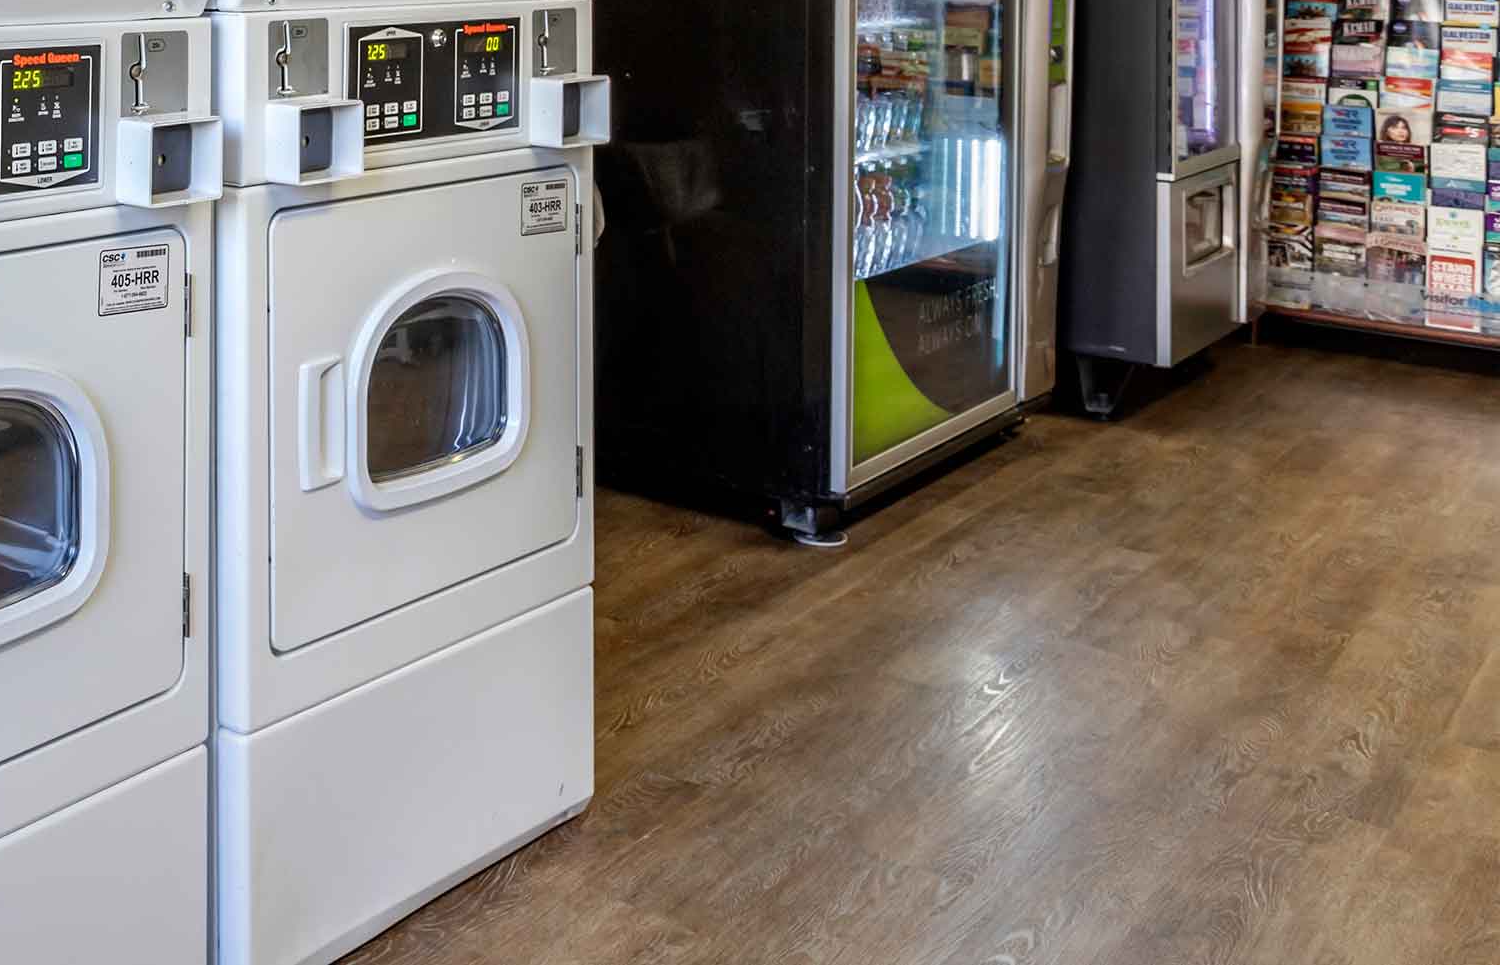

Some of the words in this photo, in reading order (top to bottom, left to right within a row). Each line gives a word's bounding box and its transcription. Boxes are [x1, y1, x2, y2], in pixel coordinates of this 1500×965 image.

[486, 37, 499, 51] 00
[13, 54, 46, 67] Speed
[48, 53, 80, 63] Queen
[13, 70, 41, 89] 2.25
[103, 254, 120, 262] CSC
[111, 270, 159, 288] 405-HRR
